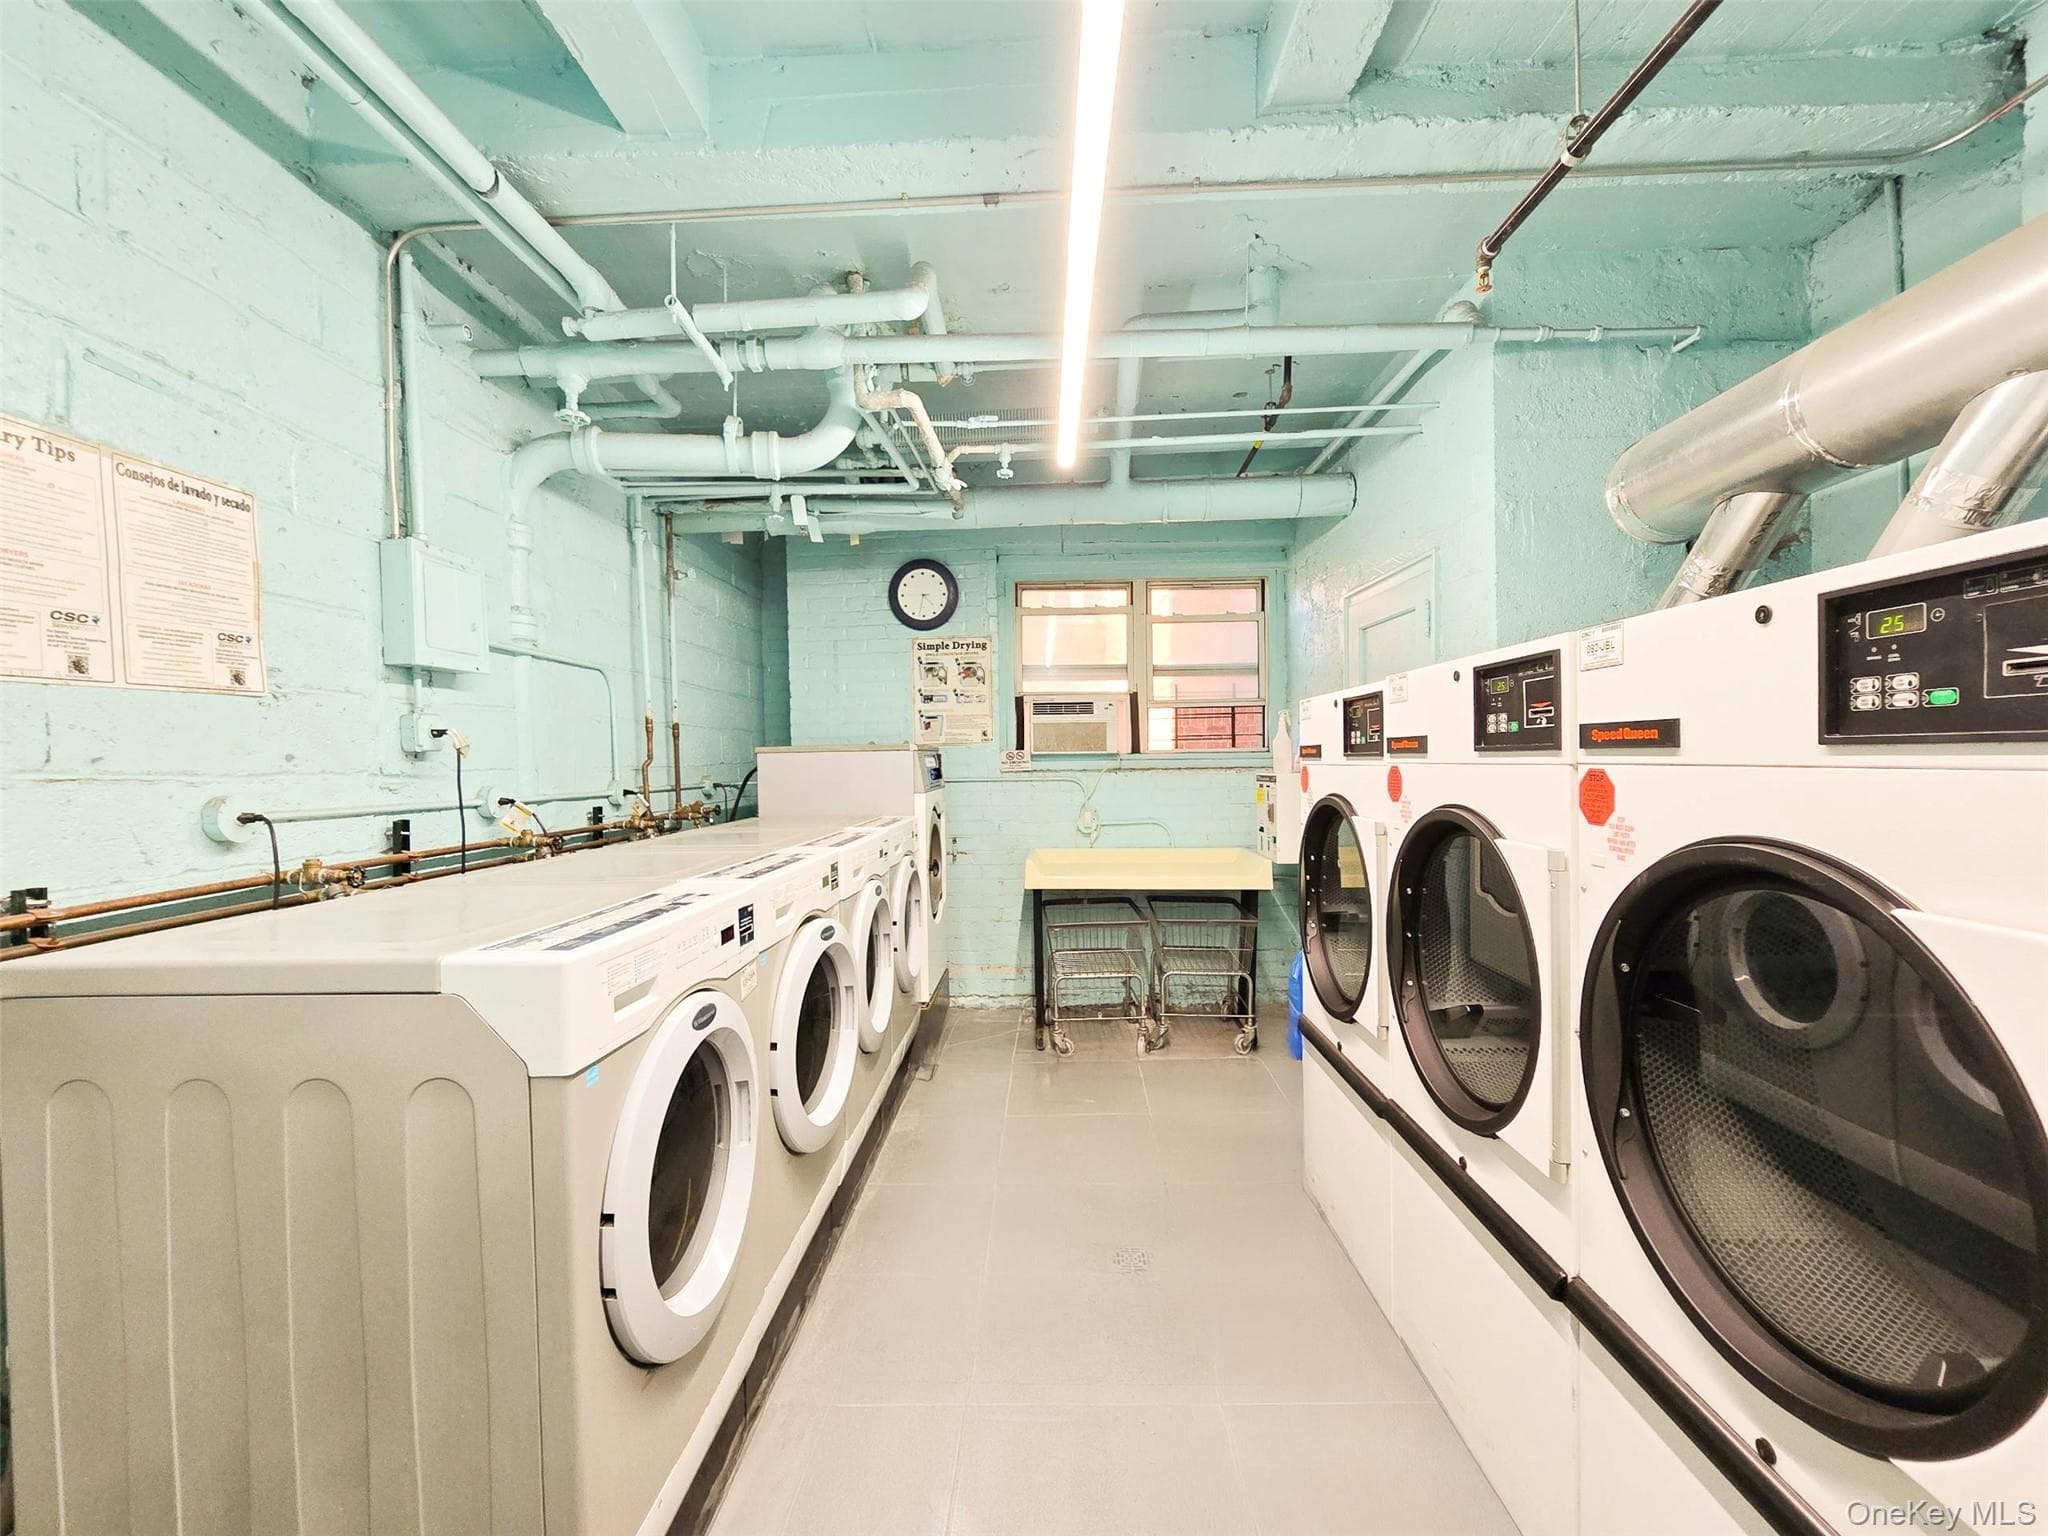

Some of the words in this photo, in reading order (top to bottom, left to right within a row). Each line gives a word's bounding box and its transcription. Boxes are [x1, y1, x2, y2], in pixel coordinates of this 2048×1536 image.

[0, 431, 25, 450] ry
[31, 436, 76, 463] Tips
[115, 462, 166, 489] Consejos
[168, 477, 180, 492] de
[182, 481, 212, 502] lavado
[213, 494, 220, 507] y
[222, 496, 251, 513] secado
[50, 610, 89, 624] CSC
[1880, 615, 1904, 633] 25
[217, 632, 244, 643] CSC
[917, 641, 950, 652] Simple
[952, 641, 988, 651] Drying
[1496, 681, 1506, 691] 25
